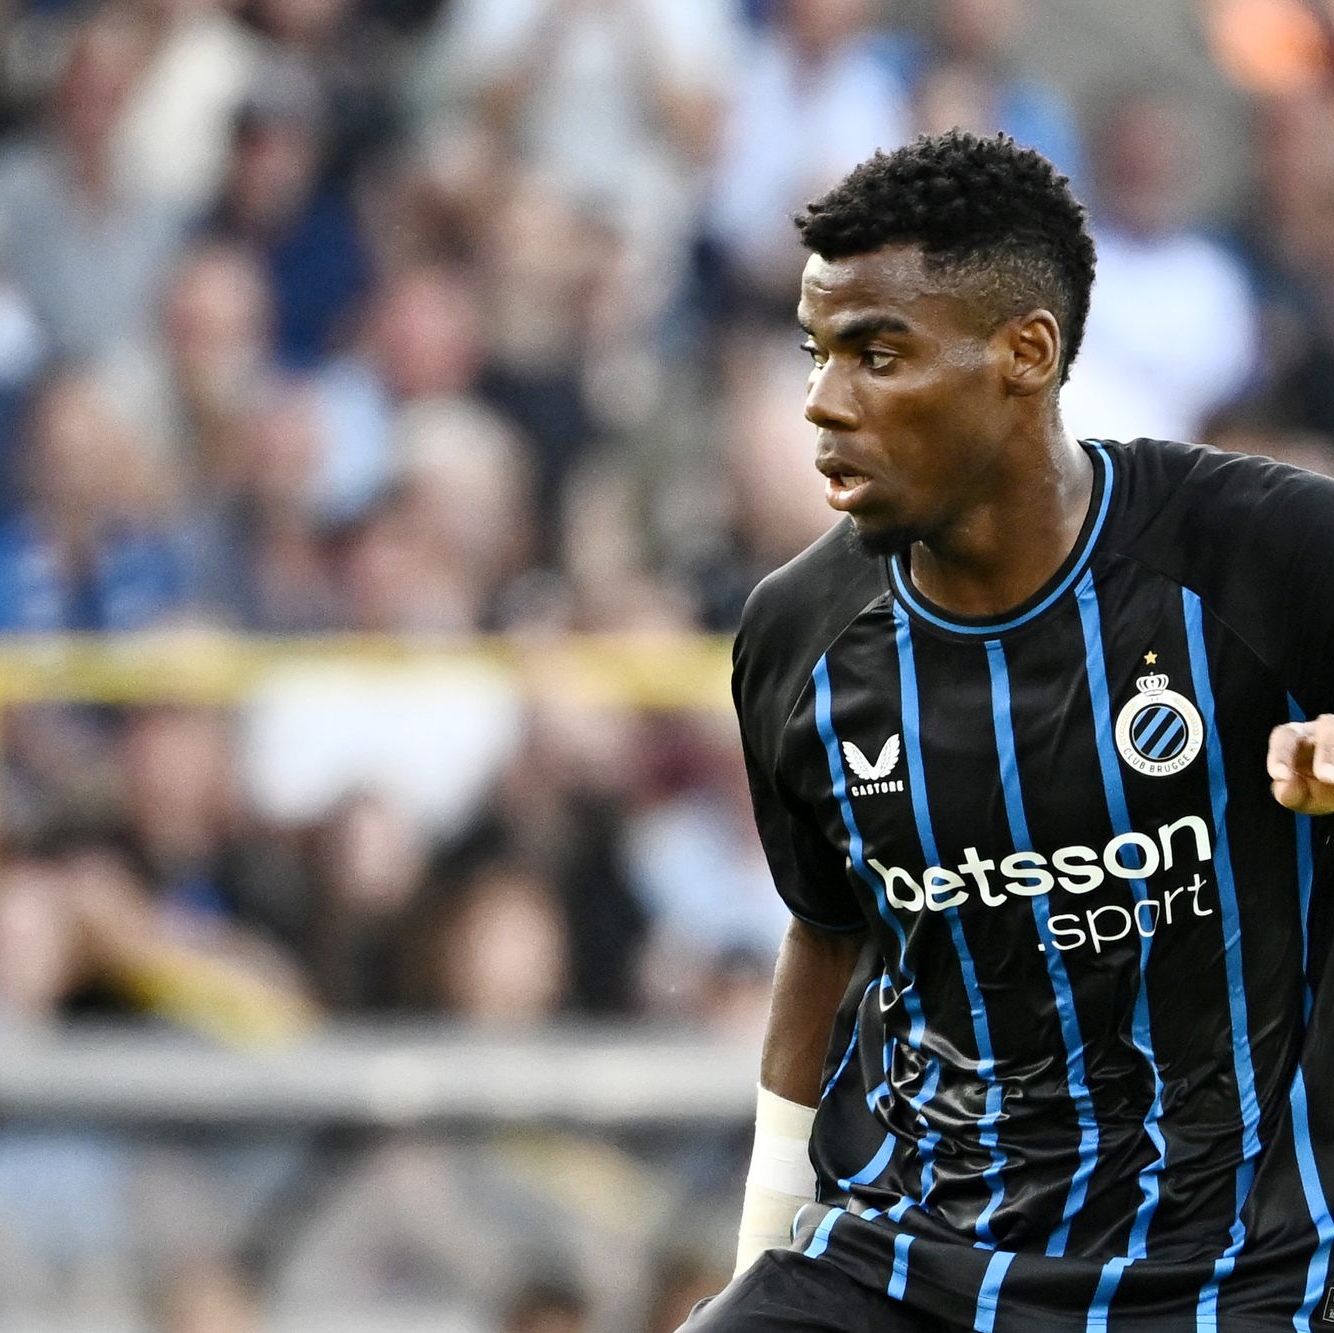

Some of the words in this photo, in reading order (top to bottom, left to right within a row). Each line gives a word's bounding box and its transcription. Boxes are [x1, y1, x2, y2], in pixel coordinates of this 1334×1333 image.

[1123, 748, 1146, 770] CLUB
[1149, 754, 1191, 773] BRUGGE
[851, 780, 904, 797] CASTORE
[867, 815, 1212, 911] betsson
